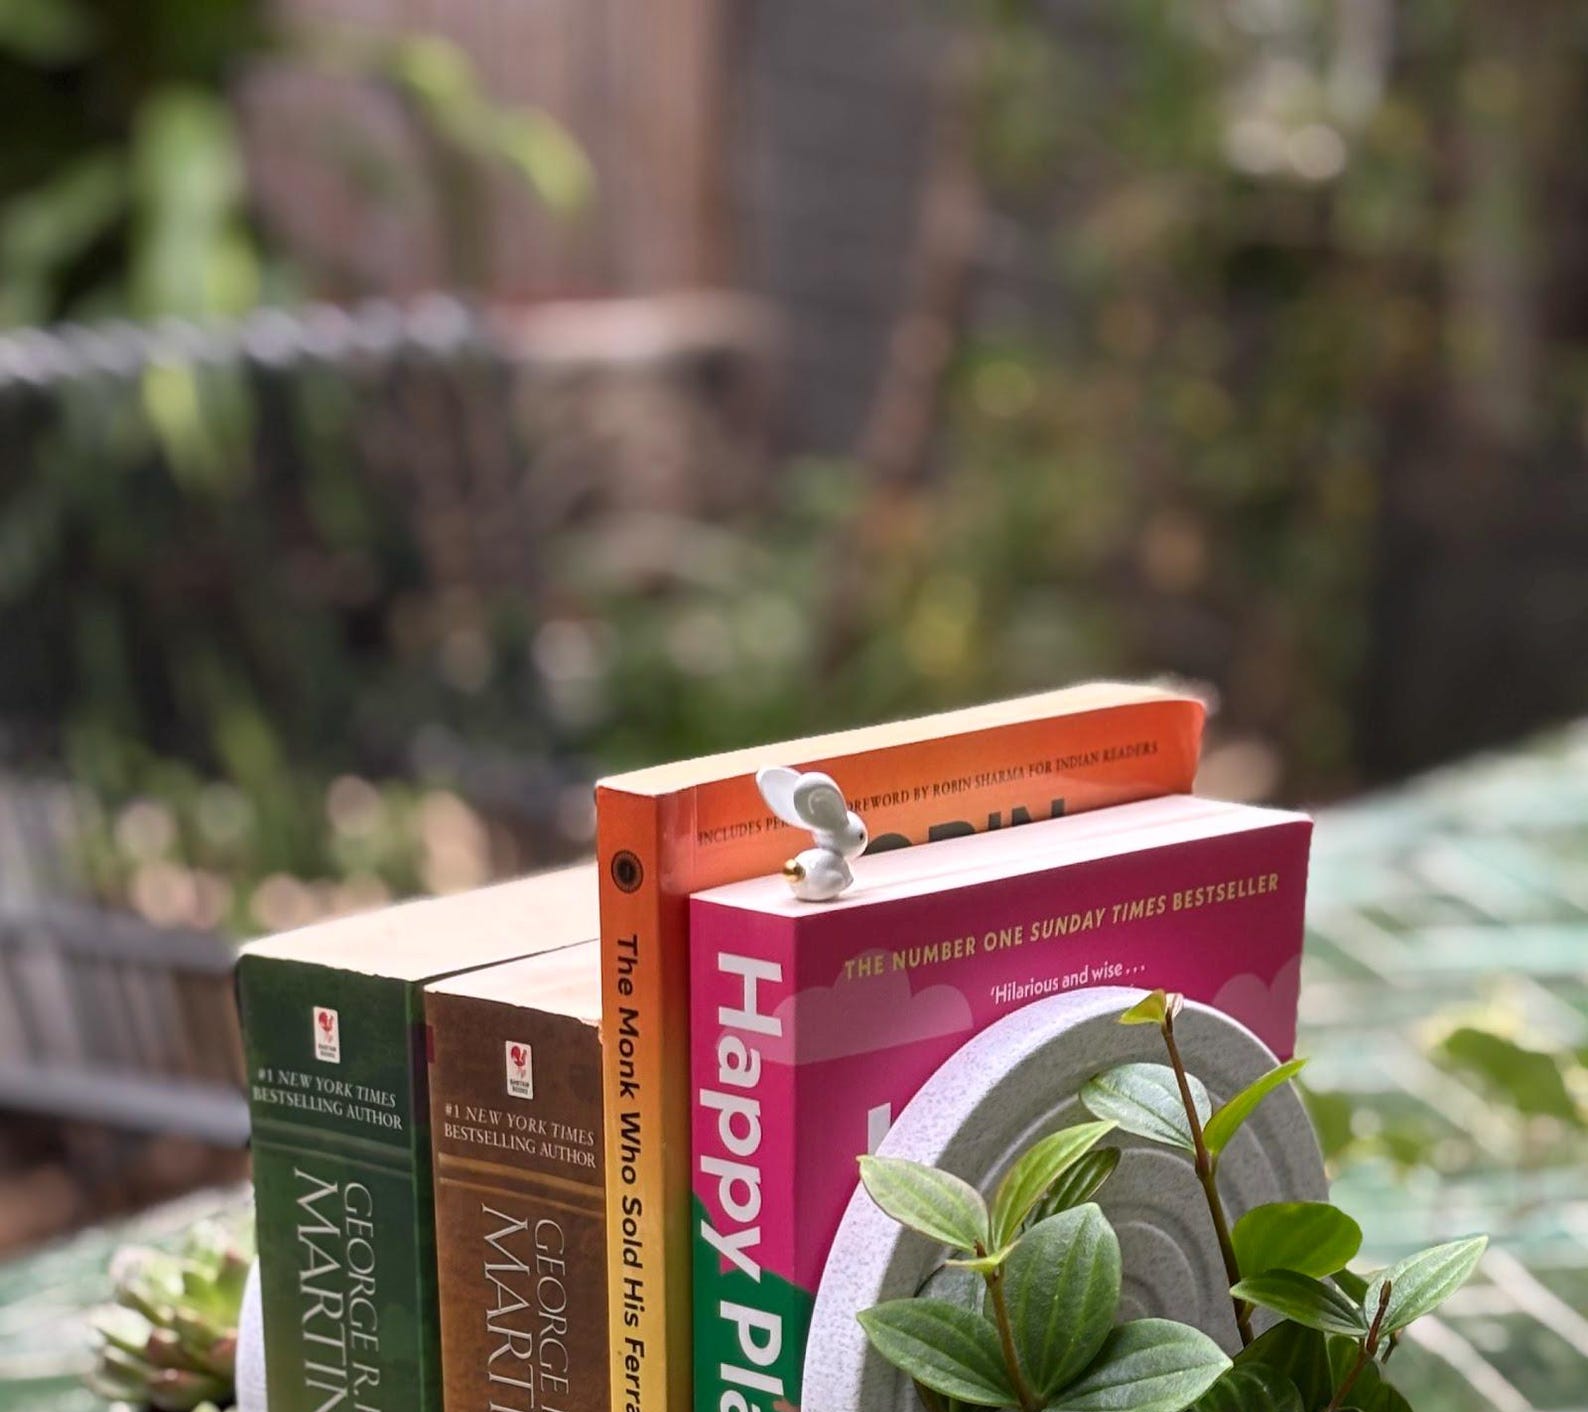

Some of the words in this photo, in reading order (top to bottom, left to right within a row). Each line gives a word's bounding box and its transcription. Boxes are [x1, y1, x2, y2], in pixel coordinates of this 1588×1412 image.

[699, 820, 762, 846] INCLUDES
[913, 785, 930, 801] BY
[933, 775, 971, 798] ROBIN
[975, 765, 1025, 788] SHARMA
[1029, 760, 1053, 778] FOR
[1055, 752, 1101, 772] INDIAN
[1102, 741, 1159, 760] READERS
[845, 953, 885, 980] THE
[892, 936, 976, 972] NUMBER
[983, 926, 1024, 951] ONE
[1030, 907, 1106, 943] SUNDAY
[1112, 895, 1167, 925] TIMES
[1172, 873, 1279, 912] BESTSELLER
[615, 935, 637, 996] The
[1062, 965, 1089, 989] and
[277, 1070, 313, 1088] NEW
[316, 1076, 353, 1098] YORK
[354, 1085, 397, 1109] TIMES
[617, 1008, 637, 1100] Monk
[252, 1086, 343, 1116] BESTSELLING
[346, 1105, 403, 1131] AUTHOR
[463, 1106, 503, 1126] NEW
[506, 1113, 548, 1136] YORK
[551, 1123, 595, 1147] TIMES
[700, 952, 784, 1283] Happy
[444, 1122, 536, 1154] BESTSELLING
[539, 1142, 597, 1169] AUTHOR
[620, 1112, 642, 1186] Who
[344, 1182, 380, 1352] GEORGE
[621, 1198, 643, 1270] Sold
[534, 1218, 570, 1394] GEORGE
[624, 1279, 644, 1327] His
